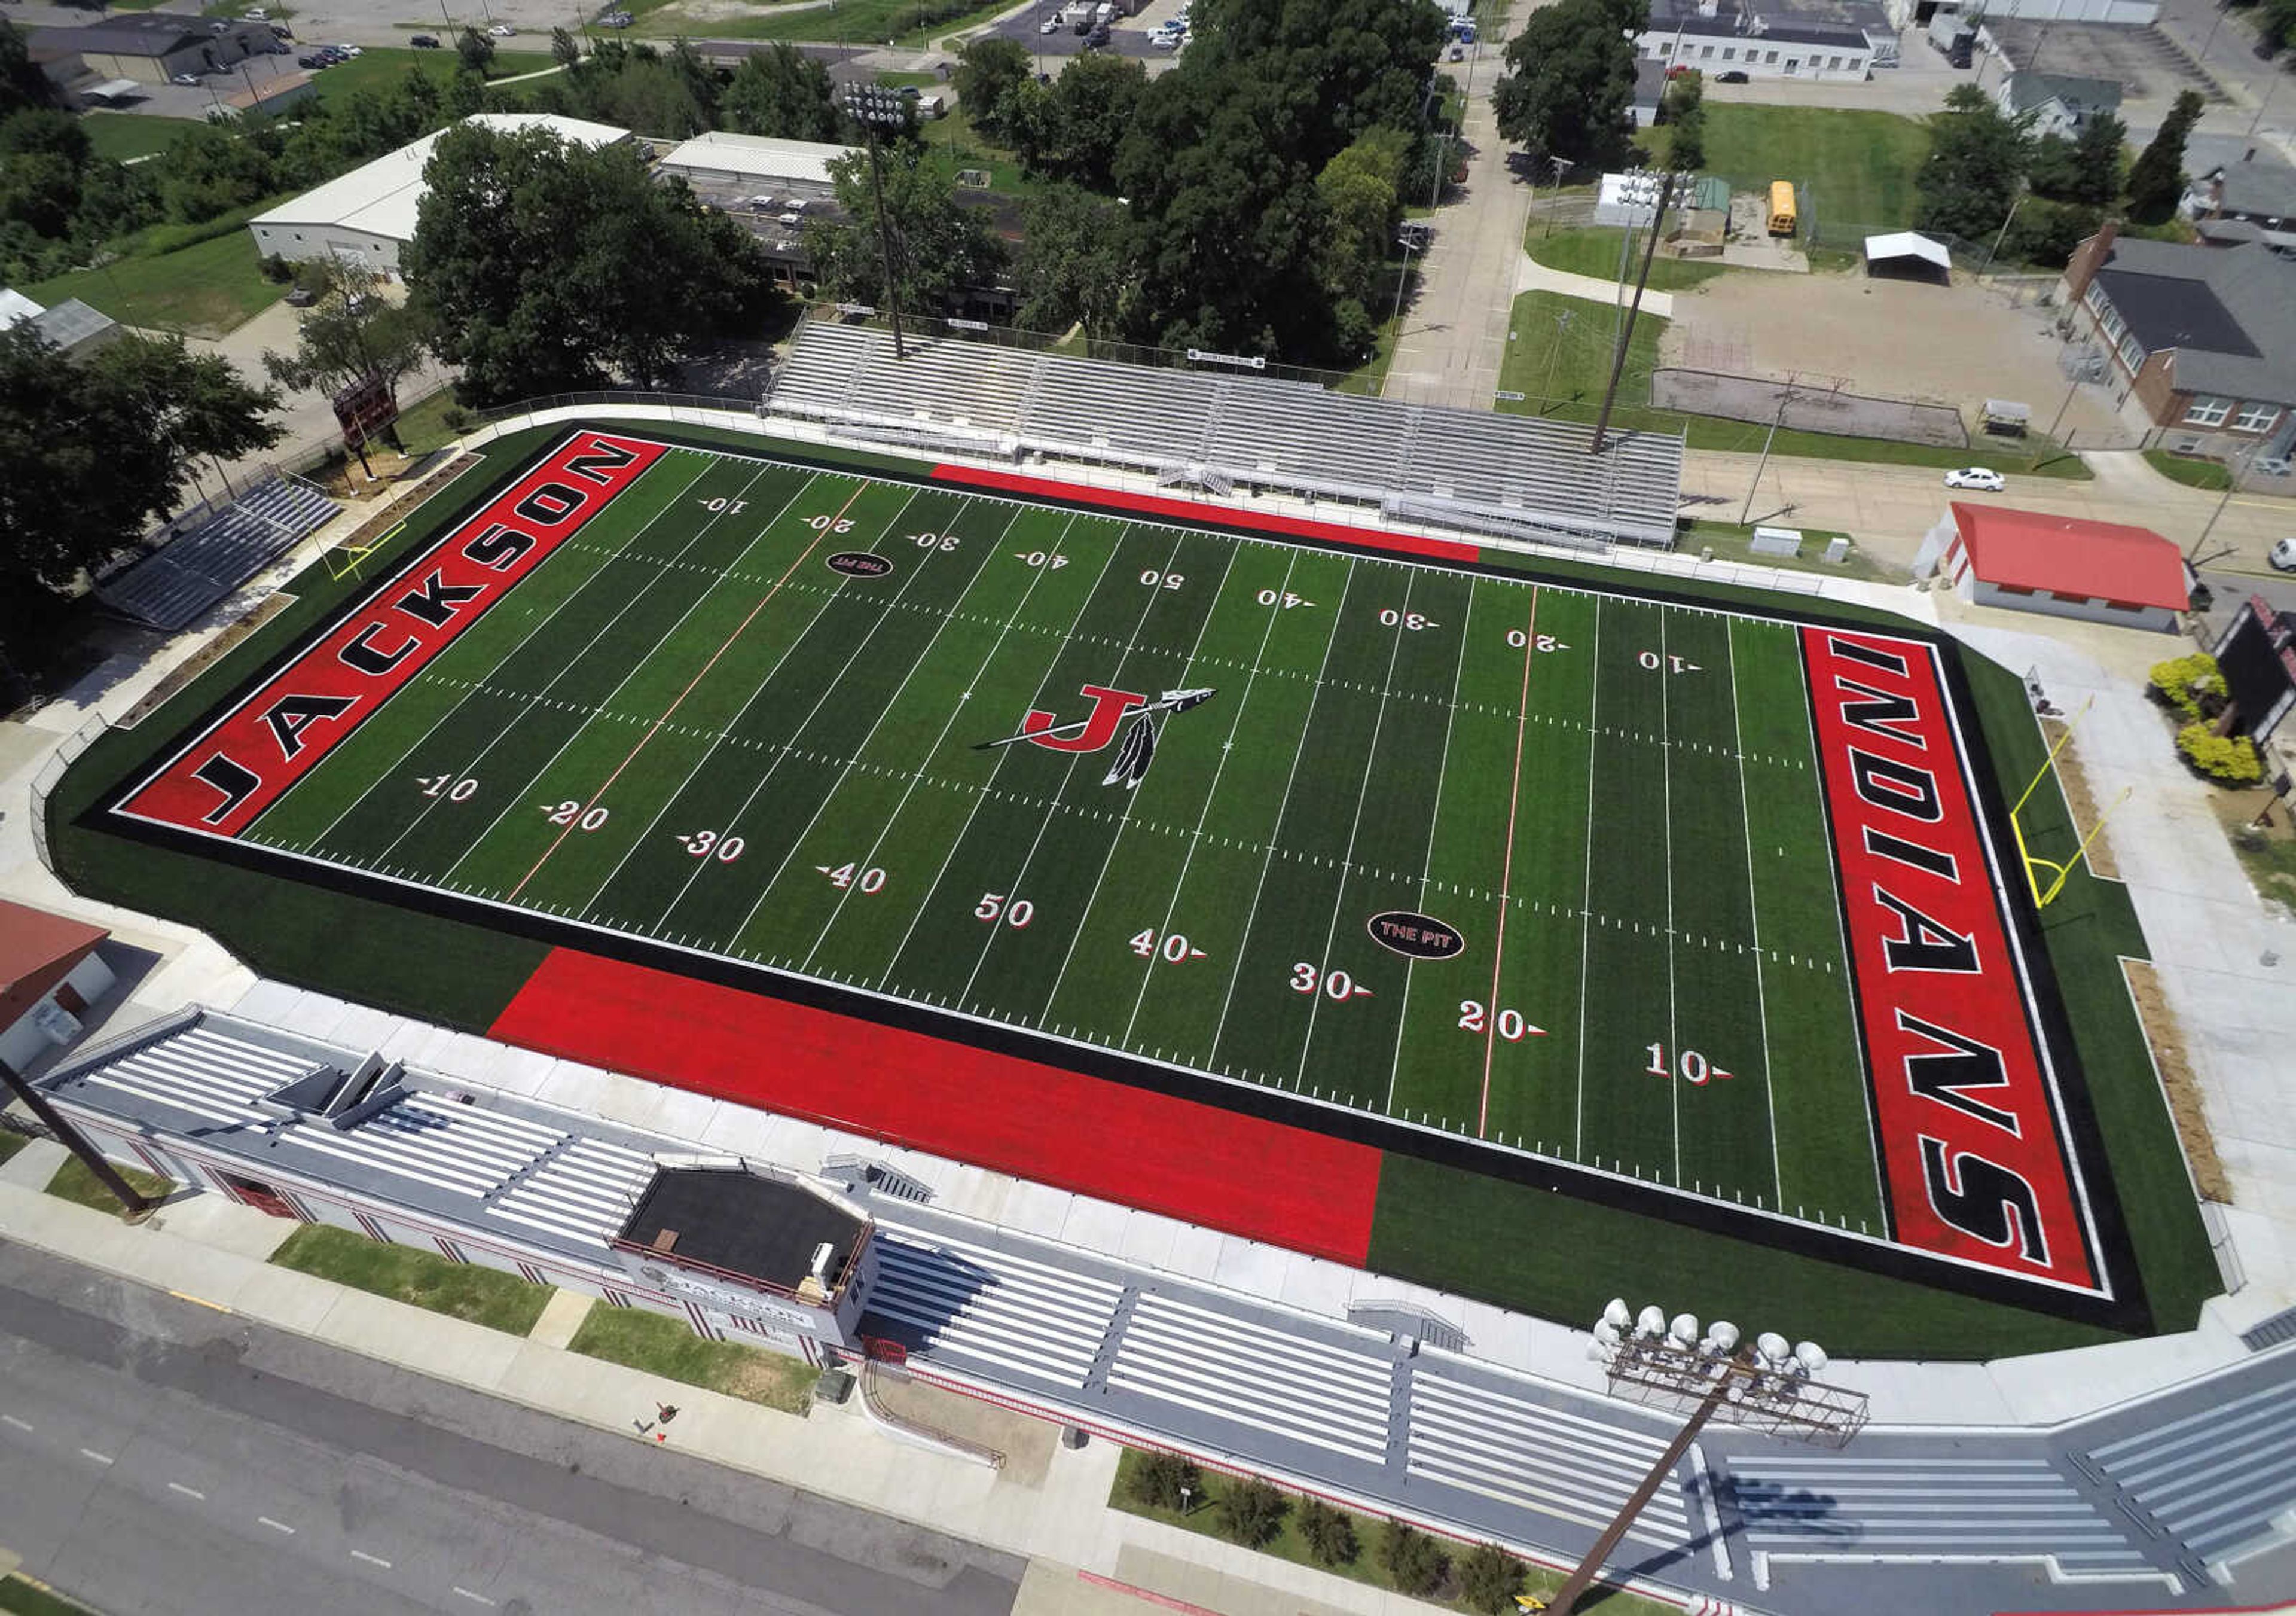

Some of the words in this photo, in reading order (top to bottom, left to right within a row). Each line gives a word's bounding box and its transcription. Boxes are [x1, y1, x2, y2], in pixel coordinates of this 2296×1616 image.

[707, 498, 750, 515] 10
[810, 515, 856, 533] 20
[917, 533, 960, 551] 30
[1028, 551, 1069, 570] 40
[1140, 570, 1185, 590] 50
[1258, 589, 1300, 610] 40
[191, 439, 640, 826] JACKSON
[1380, 608, 1428, 631] 30
[1507, 629, 1555, 653] 20
[1639, 650, 1684, 674] 10
[1023, 684, 1148, 754] J
[423, 773, 479, 803] 10
[548, 800, 609, 831] 20
[687, 830, 746, 863] 30
[829, 862, 886, 894] 40
[975, 893, 1034, 929] 50
[1129, 928, 1190, 964] 40
[1381, 921, 1418, 941] THE
[1422, 930, 1453, 948] PIT
[1828, 634, 2053, 1268] INDIANS
[1290, 962, 1354, 1002] 30
[1457, 1000, 1527, 1042] 20
[1645, 1042, 1711, 1086] 10
